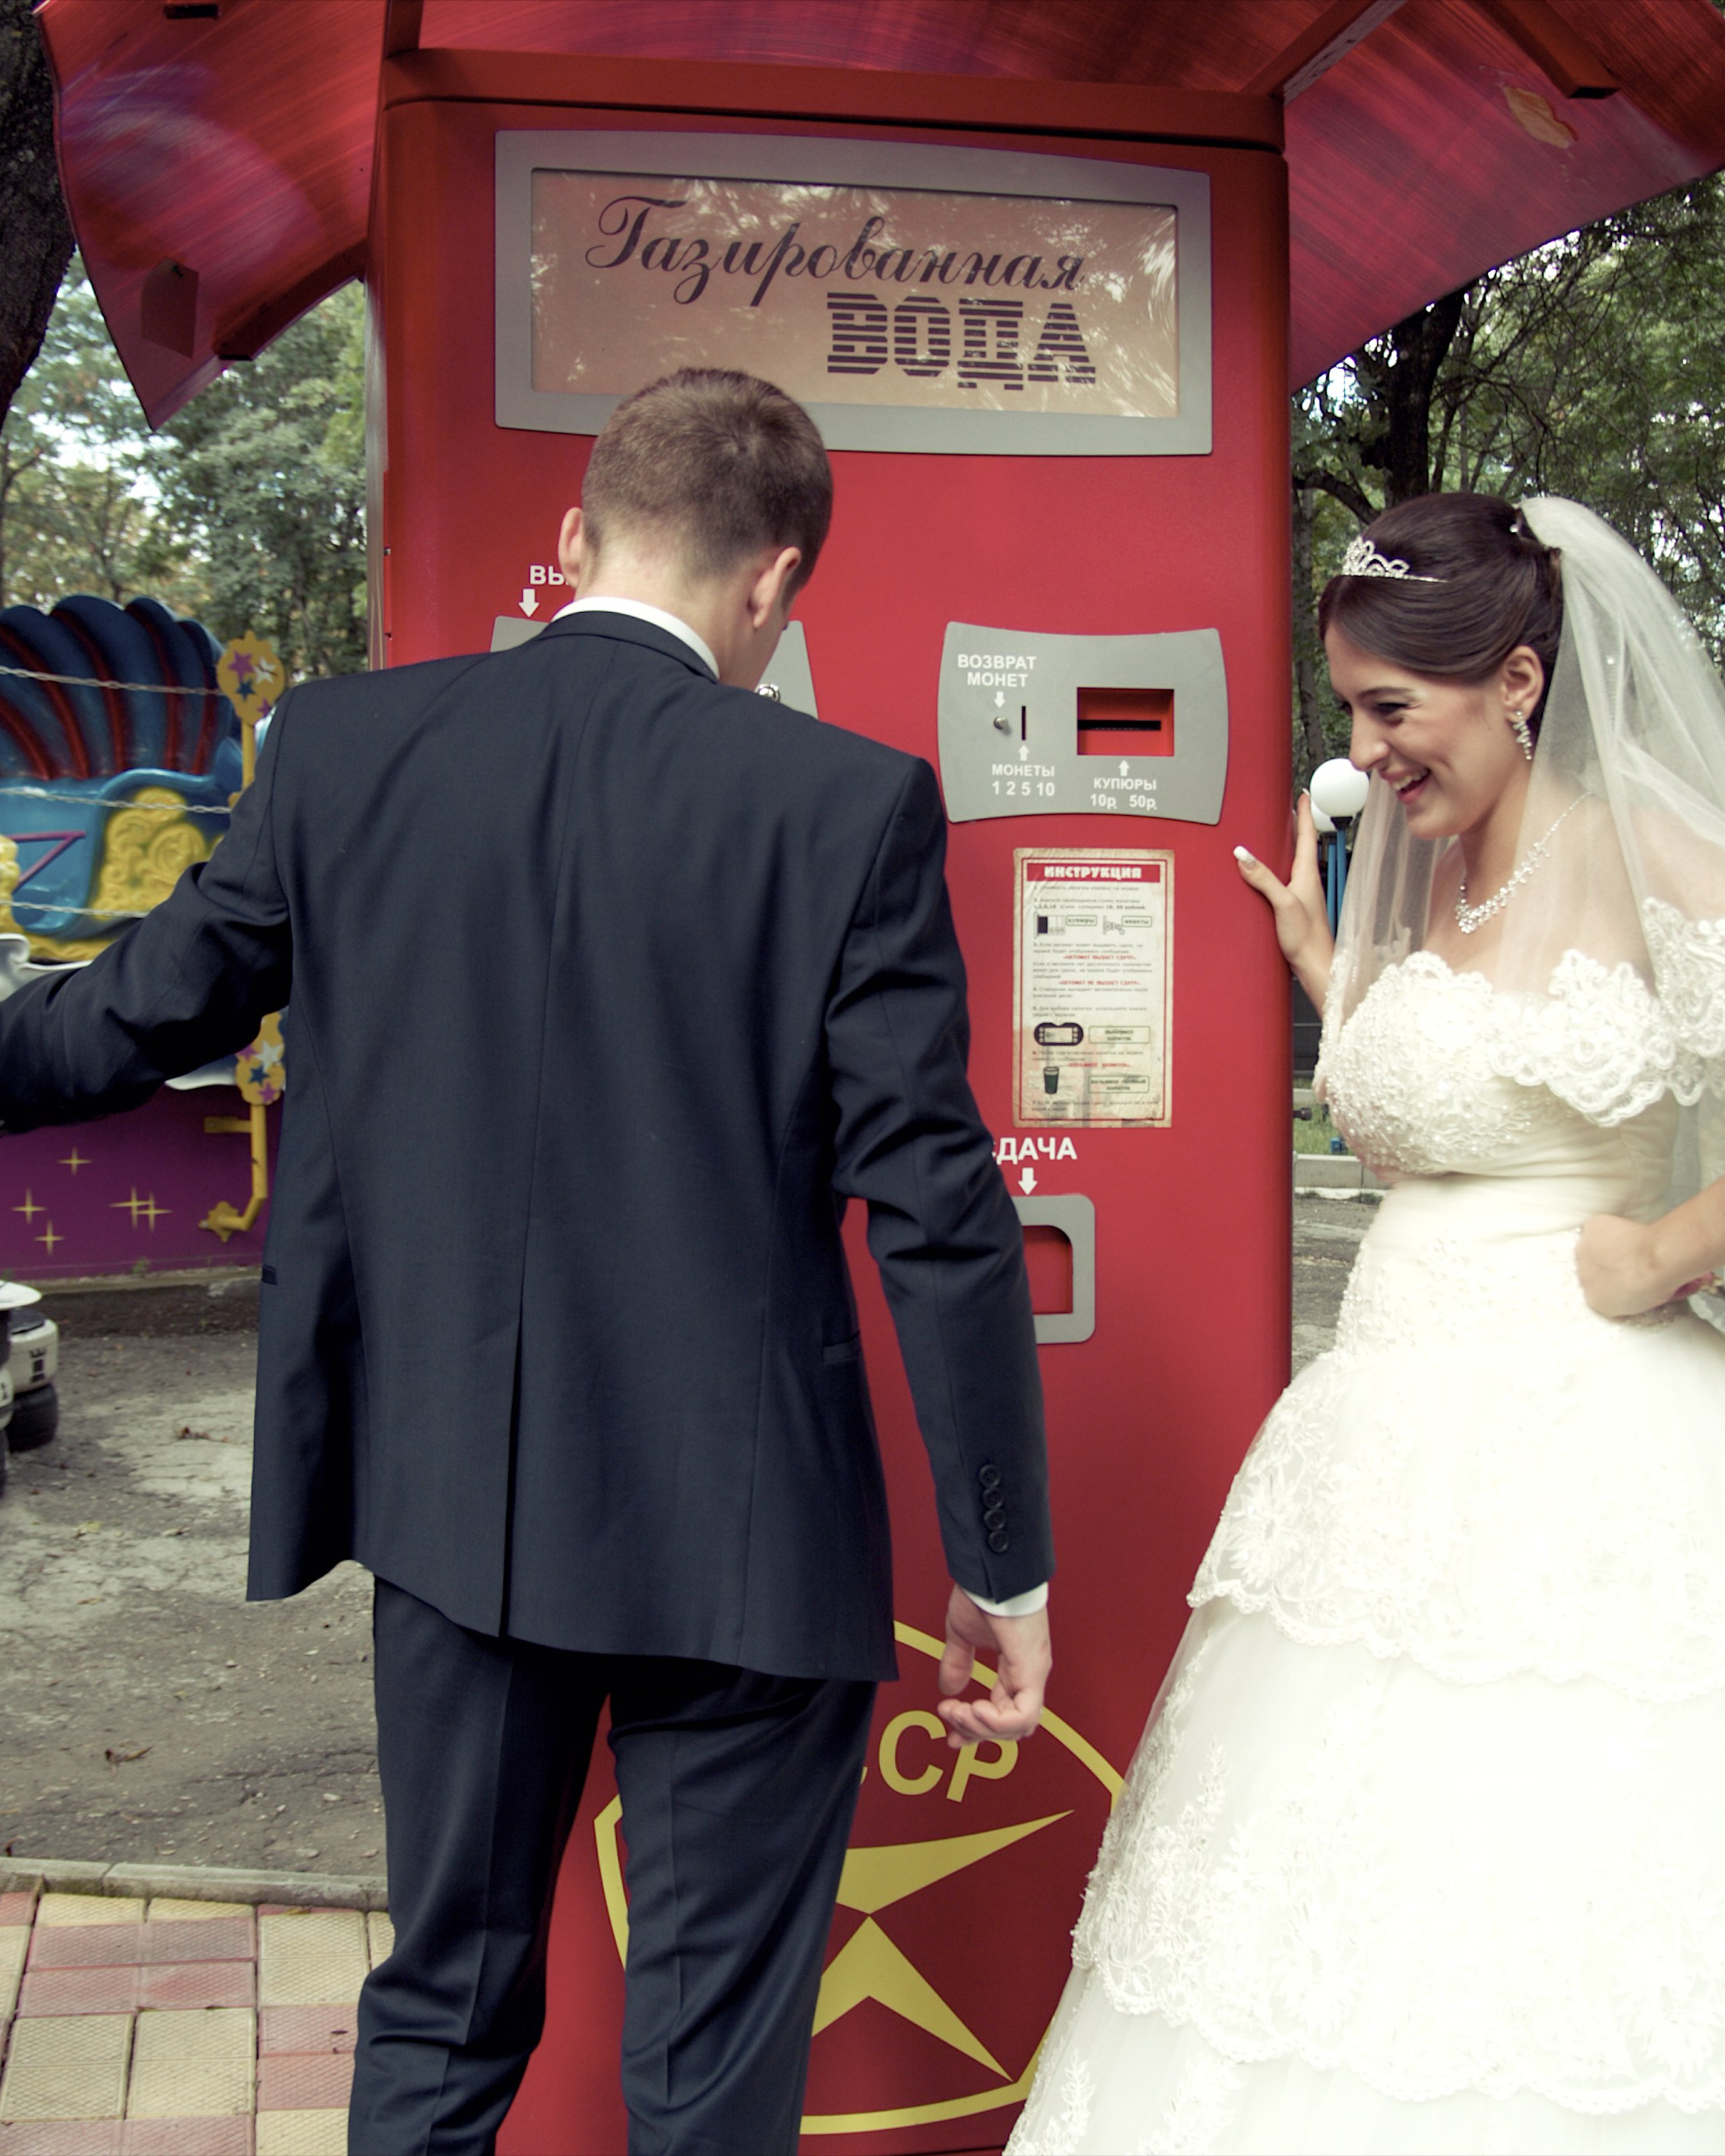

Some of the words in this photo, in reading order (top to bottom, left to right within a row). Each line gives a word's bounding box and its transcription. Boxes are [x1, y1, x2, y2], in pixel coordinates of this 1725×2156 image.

[584, 195, 1087, 306] Газированная
[827, 292, 1096, 390] ВОДА
[530, 565, 569, 585] ВЫ
[958, 654, 1036, 670] ВОЗВРАТ
[967, 672, 1028, 687] МОНЕТ
[992, 764, 1055, 777] МОНЕТЫ
[992, 782, 1000, 795] 1
[1006, 782, 1015, 796] 2
[1021, 782, 1030, 796] 5
[1037, 782, 1055, 796] 10
[1094, 778, 1157, 791] КУПЮРЫ
[1044, 866, 1141, 880] ИНСТРУКЦИЯ
[992, 1137, 1077, 1165] ДАЧА
[860, 1710, 1019, 1803] СР
